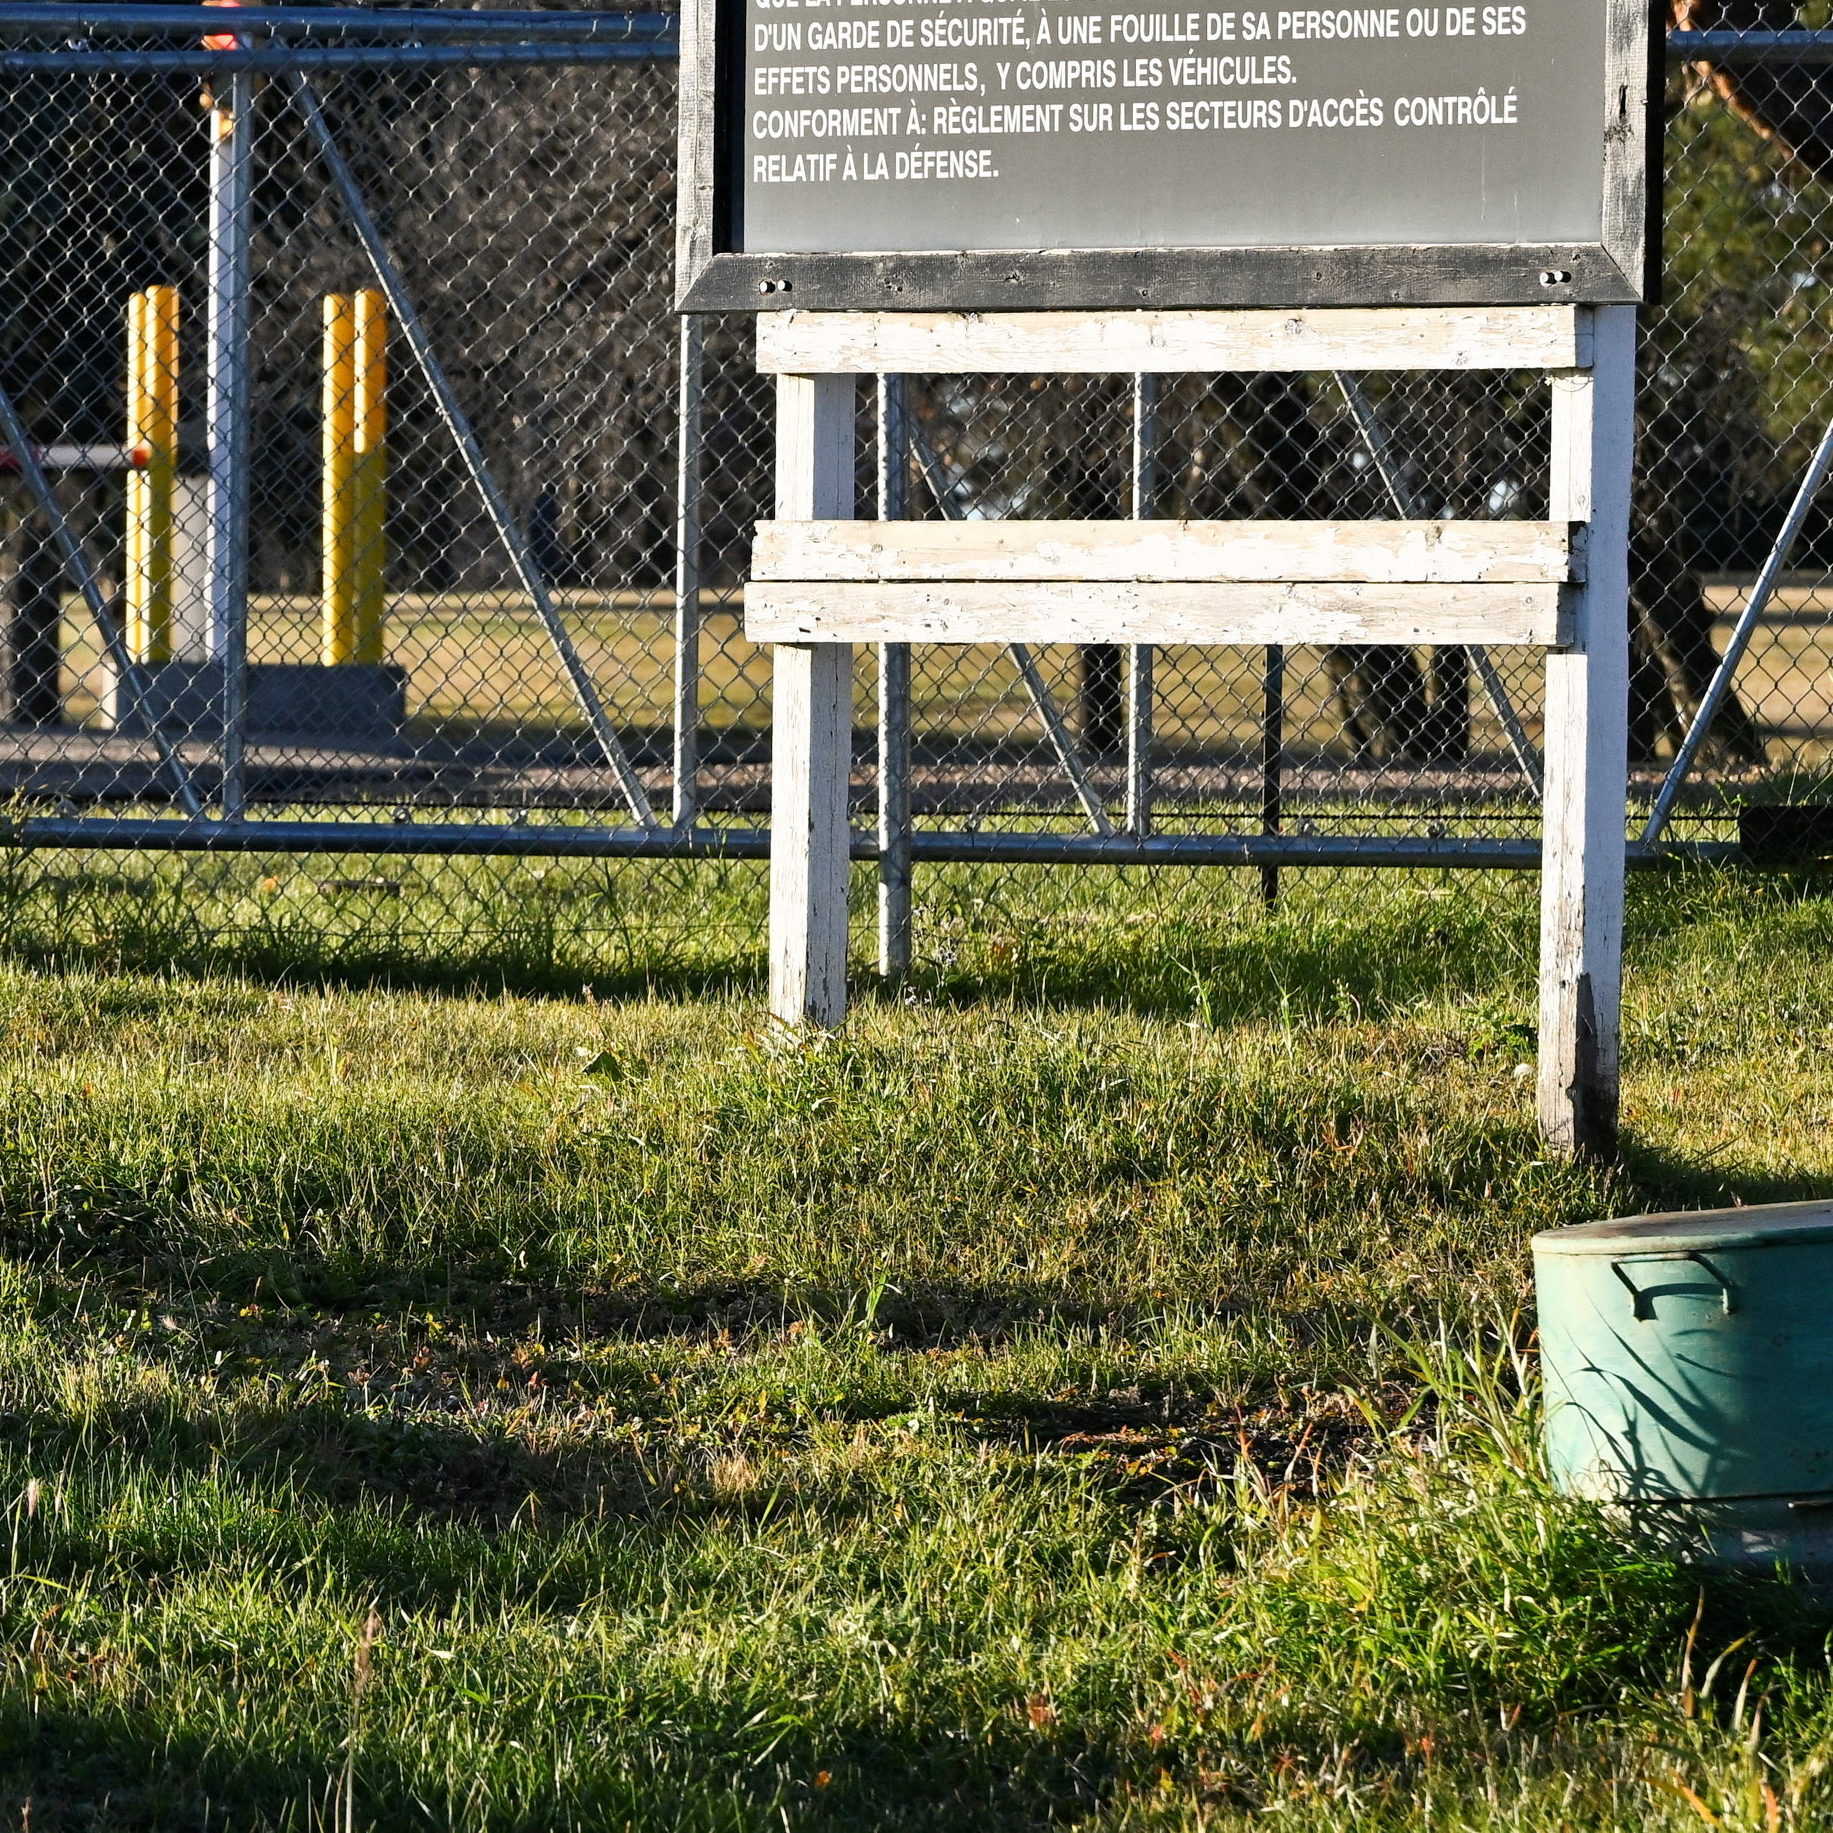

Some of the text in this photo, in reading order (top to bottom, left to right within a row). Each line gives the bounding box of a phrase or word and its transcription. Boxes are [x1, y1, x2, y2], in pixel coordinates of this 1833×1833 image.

[753, 5, 1527, 53] D'UN GARDE DE SÉCURITÉ, À UNE FOUILLE DE SA PERSONNE OU DE SES
[753, 47, 1298, 98] EFFETS PERSONNELS, Y COMPRIS LES VÉHICULES.
[752, 85, 1519, 141] CONFORMENT À: RÈGLEMENT SUR LES SECTEURS D'ACCÈS CONTRÔLÉ
[752, 142, 1000, 184] RELATIF À LA DÉFENSE.
